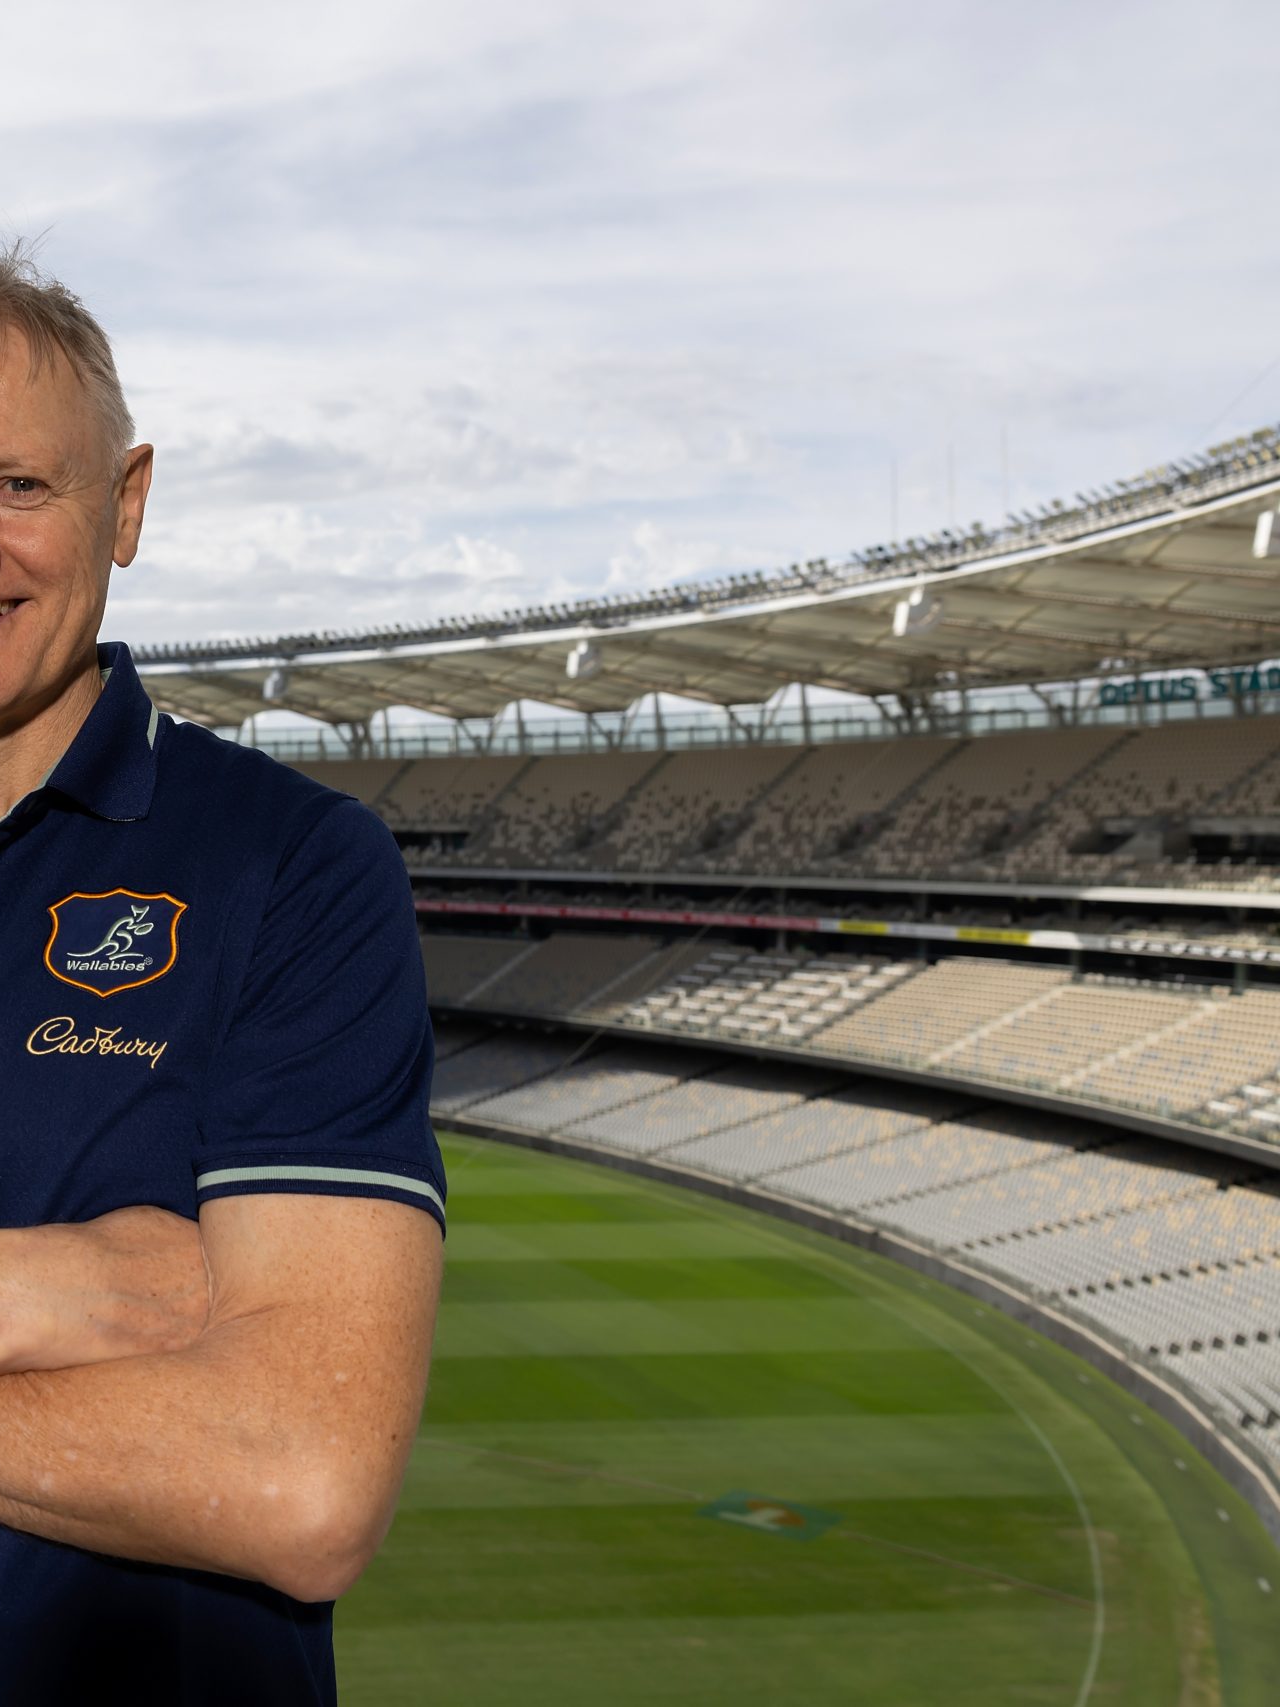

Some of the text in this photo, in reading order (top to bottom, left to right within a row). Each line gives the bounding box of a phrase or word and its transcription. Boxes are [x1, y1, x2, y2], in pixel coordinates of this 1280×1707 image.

[1100, 676, 1197, 705] OPTUS
[66, 960, 145, 972] Wallabies
[26, 1016, 168, 1069] Cadbury
